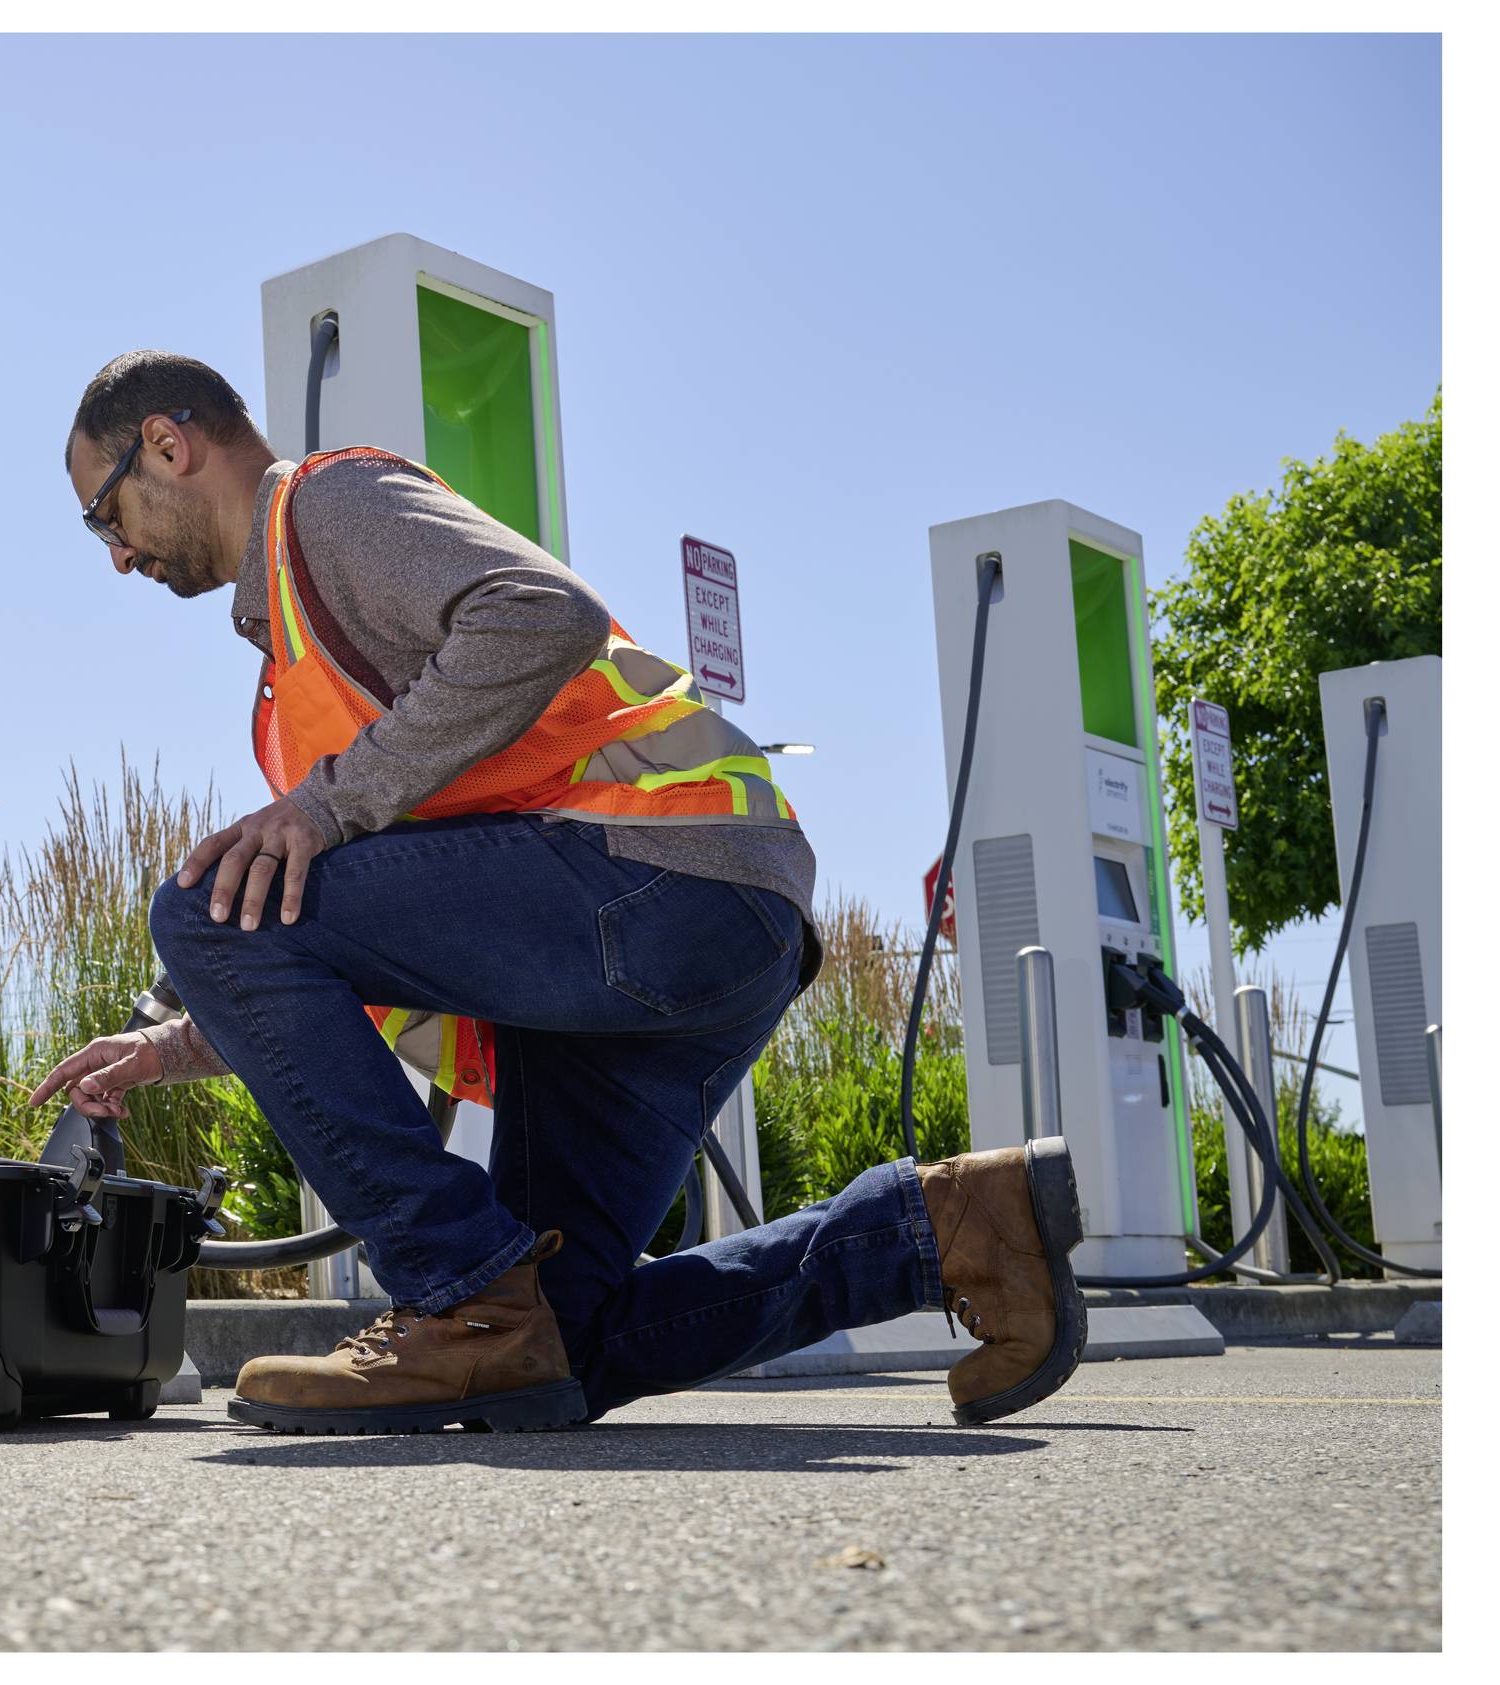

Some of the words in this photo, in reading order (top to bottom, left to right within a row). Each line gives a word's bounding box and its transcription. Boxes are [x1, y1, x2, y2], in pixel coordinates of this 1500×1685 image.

[686, 543, 700, 571] NO
[702, 553, 734, 580] PARKING
[695, 586, 729, 613] EXCEPT
[700, 613, 729, 638] WHILE
[693, 636, 739, 666] CHARGING
[1203, 738, 1226, 758] EXCEPT
[1206, 760, 1226, 778] WHILE
[1203, 778, 1232, 800] CHARGING
